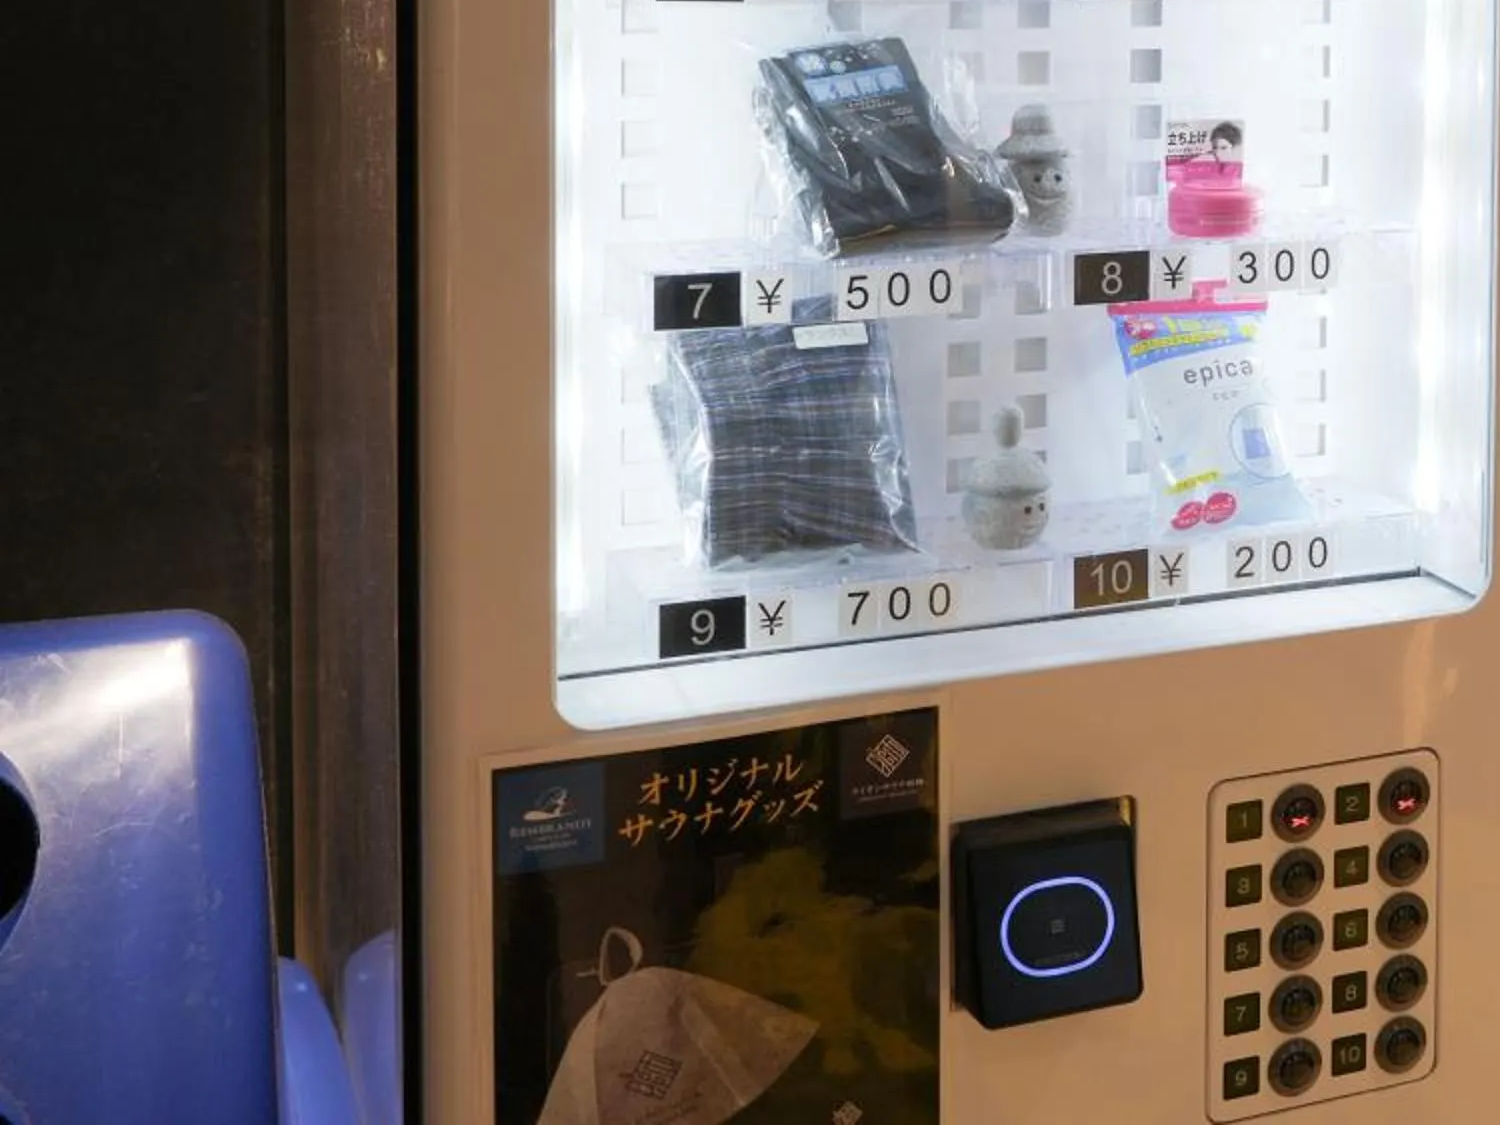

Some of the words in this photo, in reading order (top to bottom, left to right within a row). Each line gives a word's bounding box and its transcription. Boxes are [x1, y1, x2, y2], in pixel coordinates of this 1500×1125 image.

[1102, 262, 1123, 295] 8
[687, 283, 713, 320] 7
[1183, 359, 1253, 387] epica
[1090, 560, 1133, 597] 10
[690, 609, 716, 646] 9
[638, 752, 805, 806] オリジナル
[618, 779, 824, 847] サウナグッズ
[1346, 796, 1359, 812] 2
[1345, 922, 1357, 939] 6
[1236, 942, 1248, 961] 5
[1345, 985, 1357, 1001] 8
[1236, 1006, 1247, 1022] 7
[1339, 1046, 1361, 1064] 10
[1235, 1070, 1247, 1086] 9
